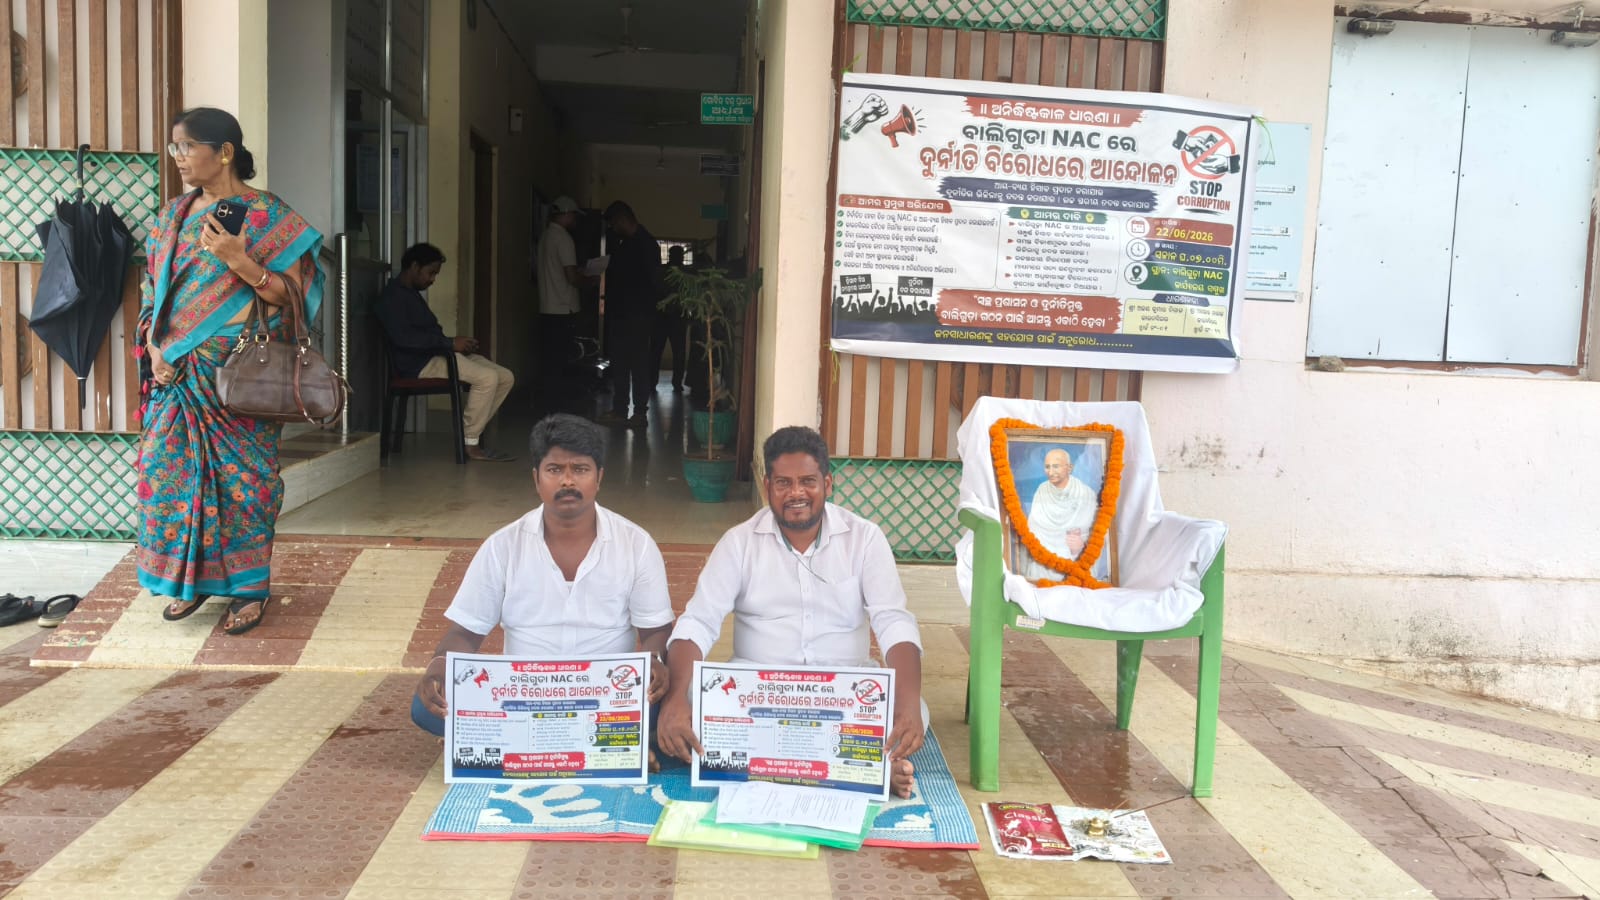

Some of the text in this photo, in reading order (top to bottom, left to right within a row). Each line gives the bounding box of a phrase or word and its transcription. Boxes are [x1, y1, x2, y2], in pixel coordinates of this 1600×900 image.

[1069, 108, 1108, 123] ଧାରଣା
[1052, 128, 1100, 148] NAC
[1106, 134, 1137, 152] ରେ
[918, 138, 1178, 186] ଦୁର୍ନୀତି ବିରୋଧରେ ଆନ୍ଦୋଳନ
[1189, 179, 1222, 197] STOP
[857, 197, 881, 206] ଆମର
[1176, 194, 1231, 210] CORRUPTION
[896, 213, 912, 221] NAC
[1033, 210, 1081, 221] ଆମର ଦାବି
[1155, 226, 1214, 241] 22/06/2026
[1203, 270, 1223, 279] NAC
[994, 296, 1027, 309] ପ୍ରଶାସନ
[1030, 298, 1038, 308] ଓ
[980, 311, 1003, 322] ଗଠନ
[1005, 310, 1024, 323] ପାଇଁ
[1080, 317, 1105, 329] ହେବା
[550, 674, 573, 683] NAC
[491, 683, 610, 700] ଦୁର୍ନୀତି ବିରୋଧରେ ଆନ୍ଦୋଳନ
[796, 683, 818, 692] NAC
[615, 691, 632, 699] STOP
[767, 692, 811, 706] ବିରୋଧରେ
[859, 705, 876, 713] STOP
[1004, 811, 1053, 824] Classic
